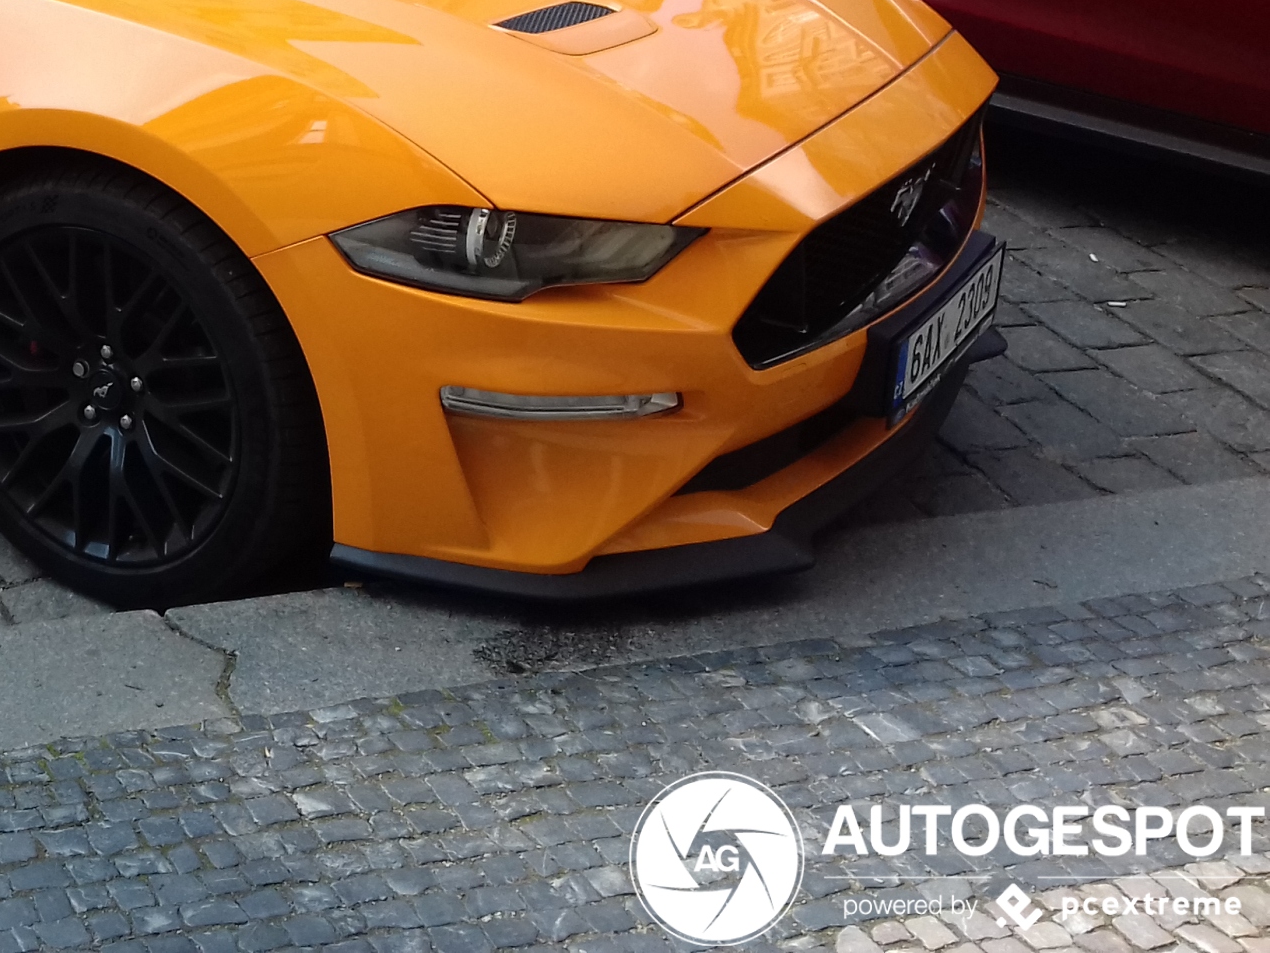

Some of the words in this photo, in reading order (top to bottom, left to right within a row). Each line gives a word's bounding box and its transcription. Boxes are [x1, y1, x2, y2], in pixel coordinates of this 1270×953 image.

[910, 312, 946, 384] 6AX
[953, 264, 994, 345] 2309
[893, 380, 904, 400] CZ
